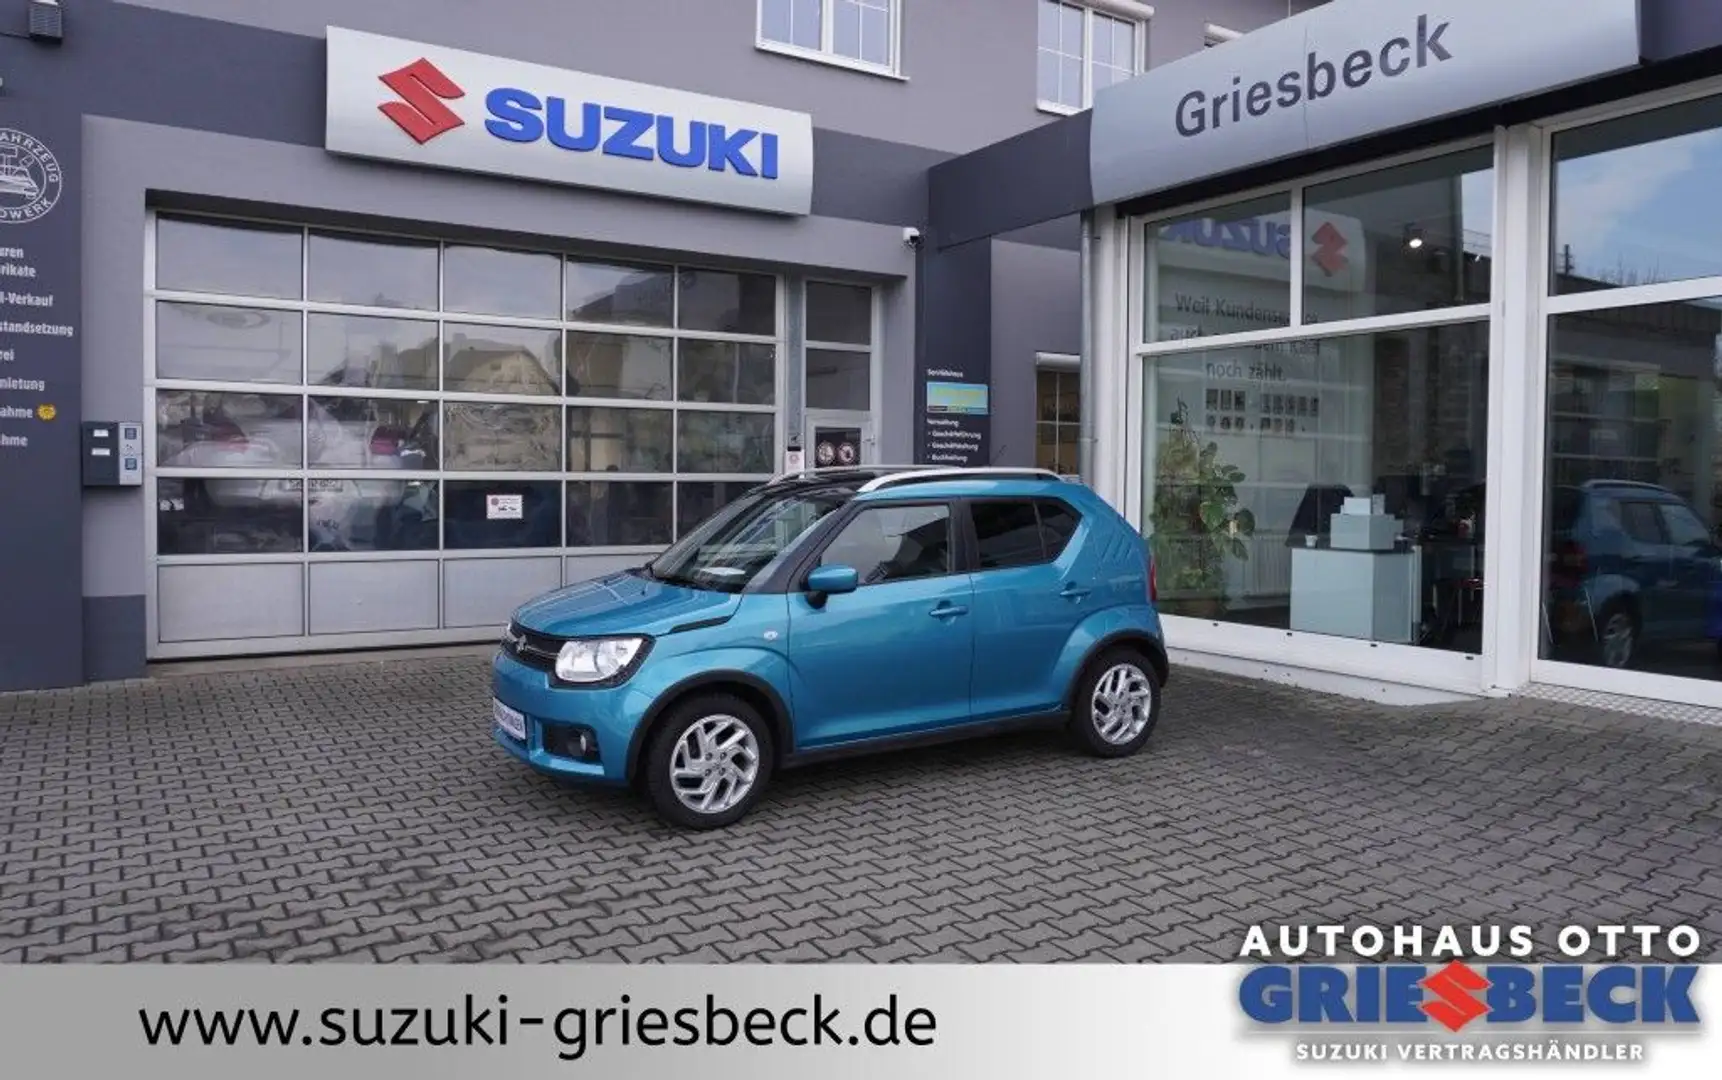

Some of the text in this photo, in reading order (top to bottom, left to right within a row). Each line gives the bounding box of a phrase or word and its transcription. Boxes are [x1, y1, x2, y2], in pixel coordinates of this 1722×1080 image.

[1175, 14, 1453, 137] Griesbeck
[484, 87, 778, 179] SUZUKI
[1206, 359, 1242, 379] noch
